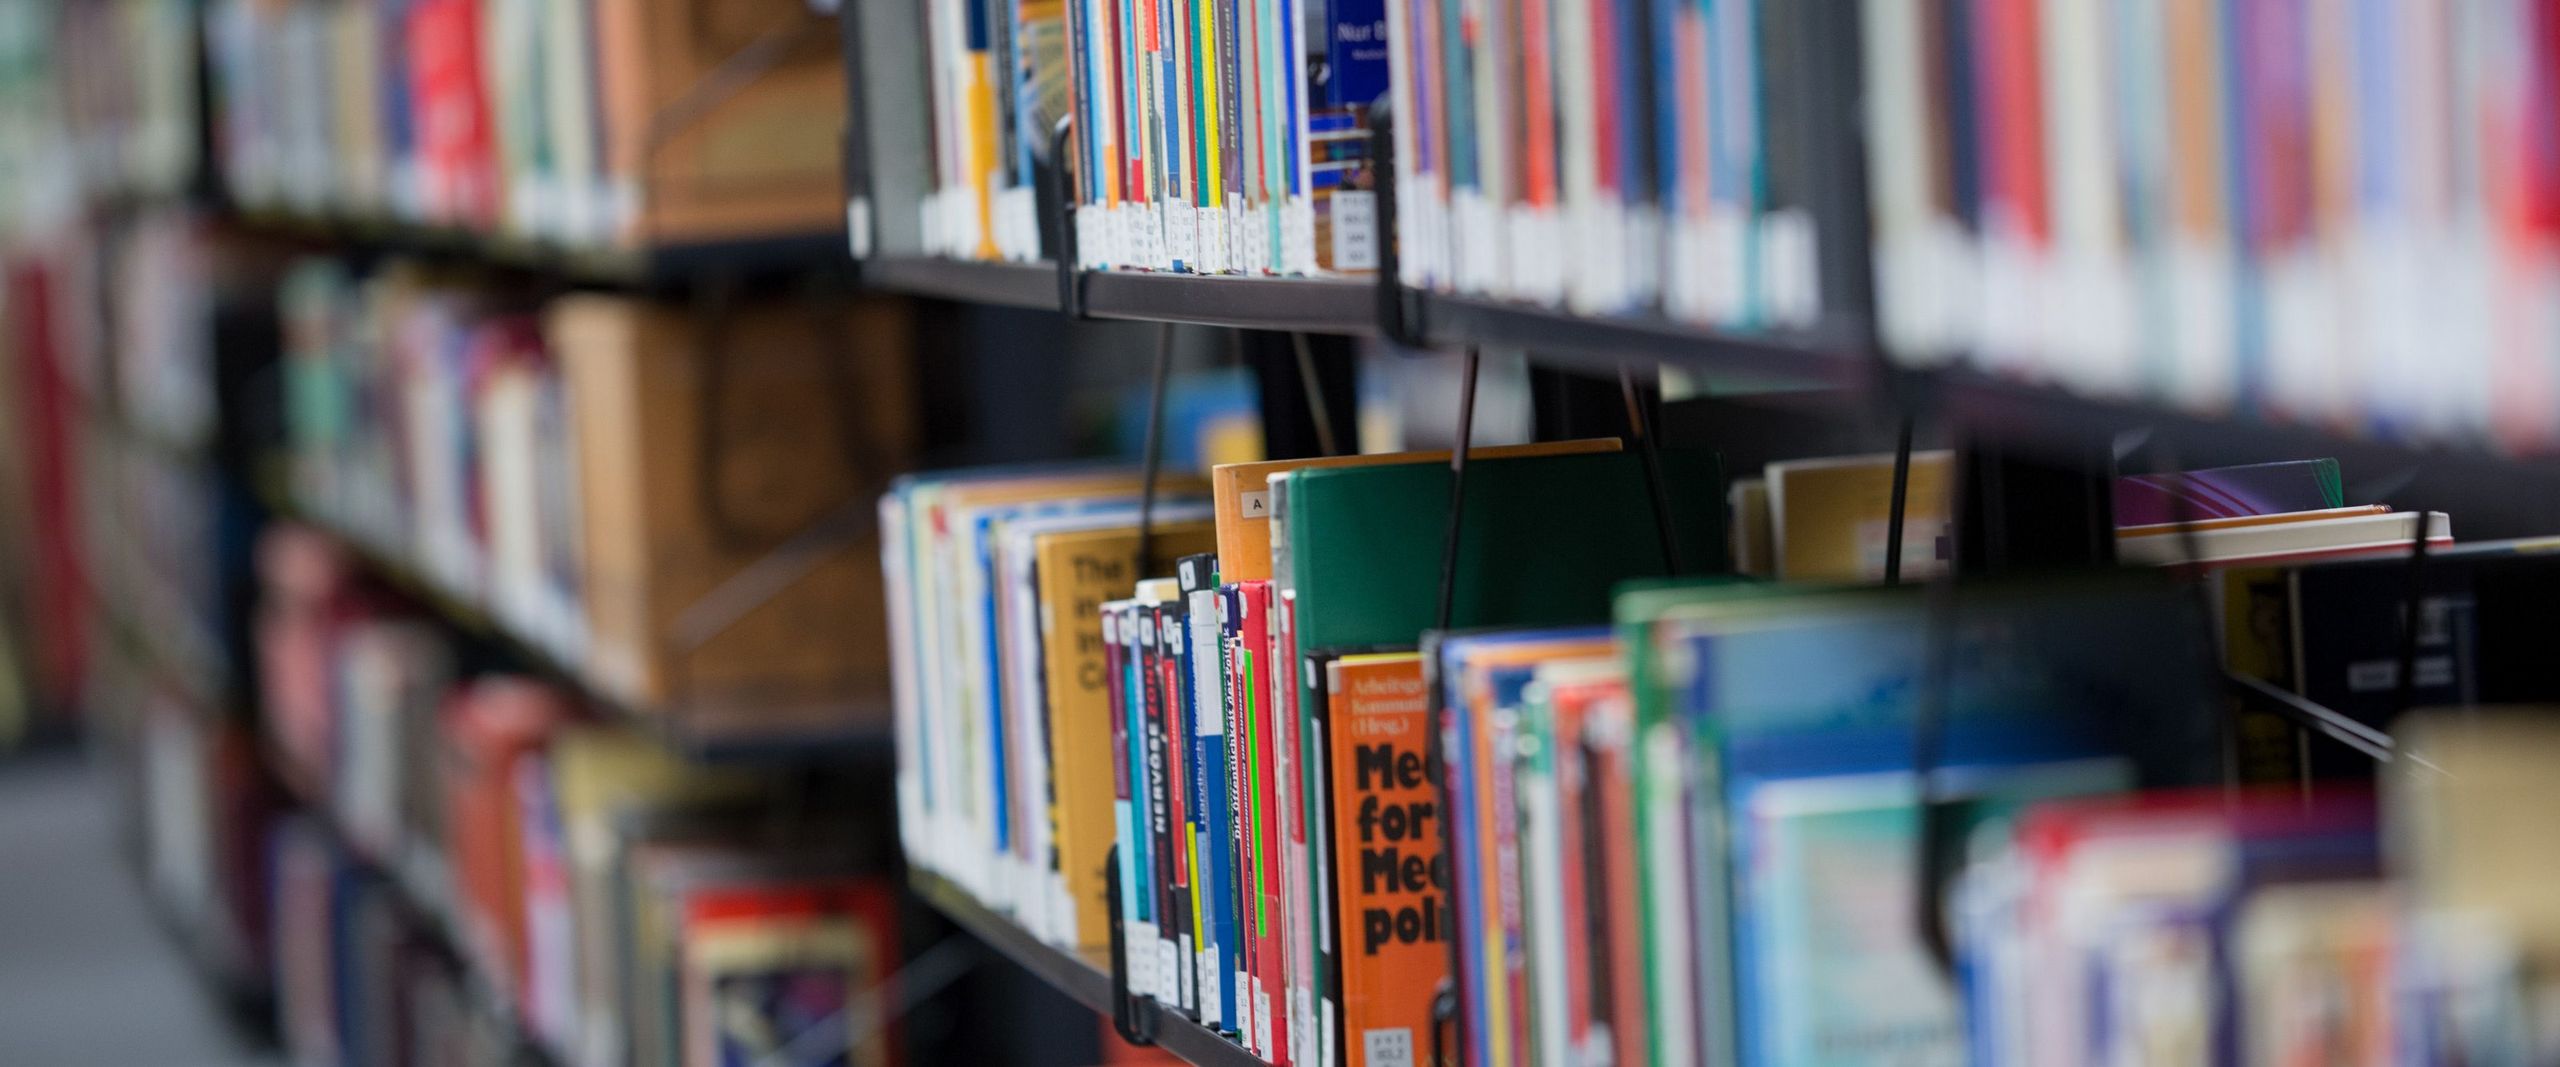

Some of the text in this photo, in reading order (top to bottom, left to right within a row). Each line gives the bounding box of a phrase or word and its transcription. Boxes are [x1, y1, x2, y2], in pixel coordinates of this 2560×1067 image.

[1253, 498, 1262, 510] A
[1223, 627, 1231, 676] Politik
[1143, 654, 1159, 718] ZONE
[1226, 680, 1234, 705] der
[1148, 722, 1167, 833] NERVÖSE
[1233, 815, 1241, 839] Die
